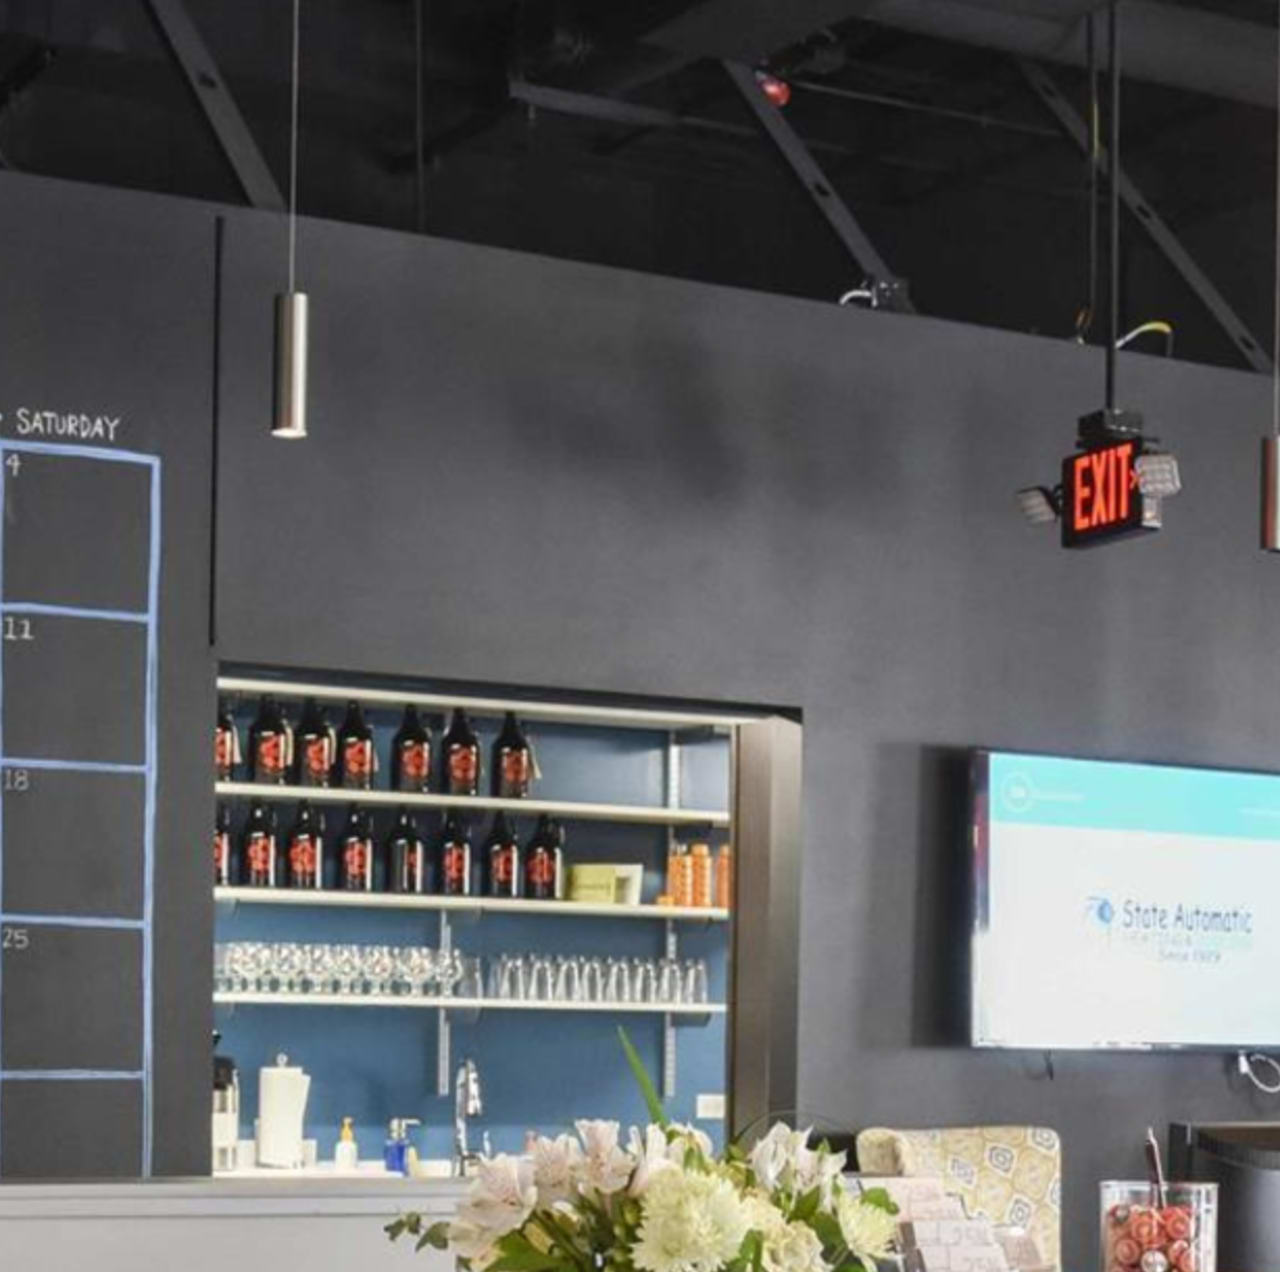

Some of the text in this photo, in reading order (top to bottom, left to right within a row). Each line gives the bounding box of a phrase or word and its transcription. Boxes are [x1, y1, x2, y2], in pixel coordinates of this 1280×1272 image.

[16, 409, 119, 441] SATURDAY
[6, 453, 20, 476] 4
[1074, 443, 1132, 530] EXIT
[4, 617, 34, 640] 11
[4, 768, 29, 791] 18
[1122, 899, 1252, 934] State Automatic
[3, 927, 29, 949] 25
